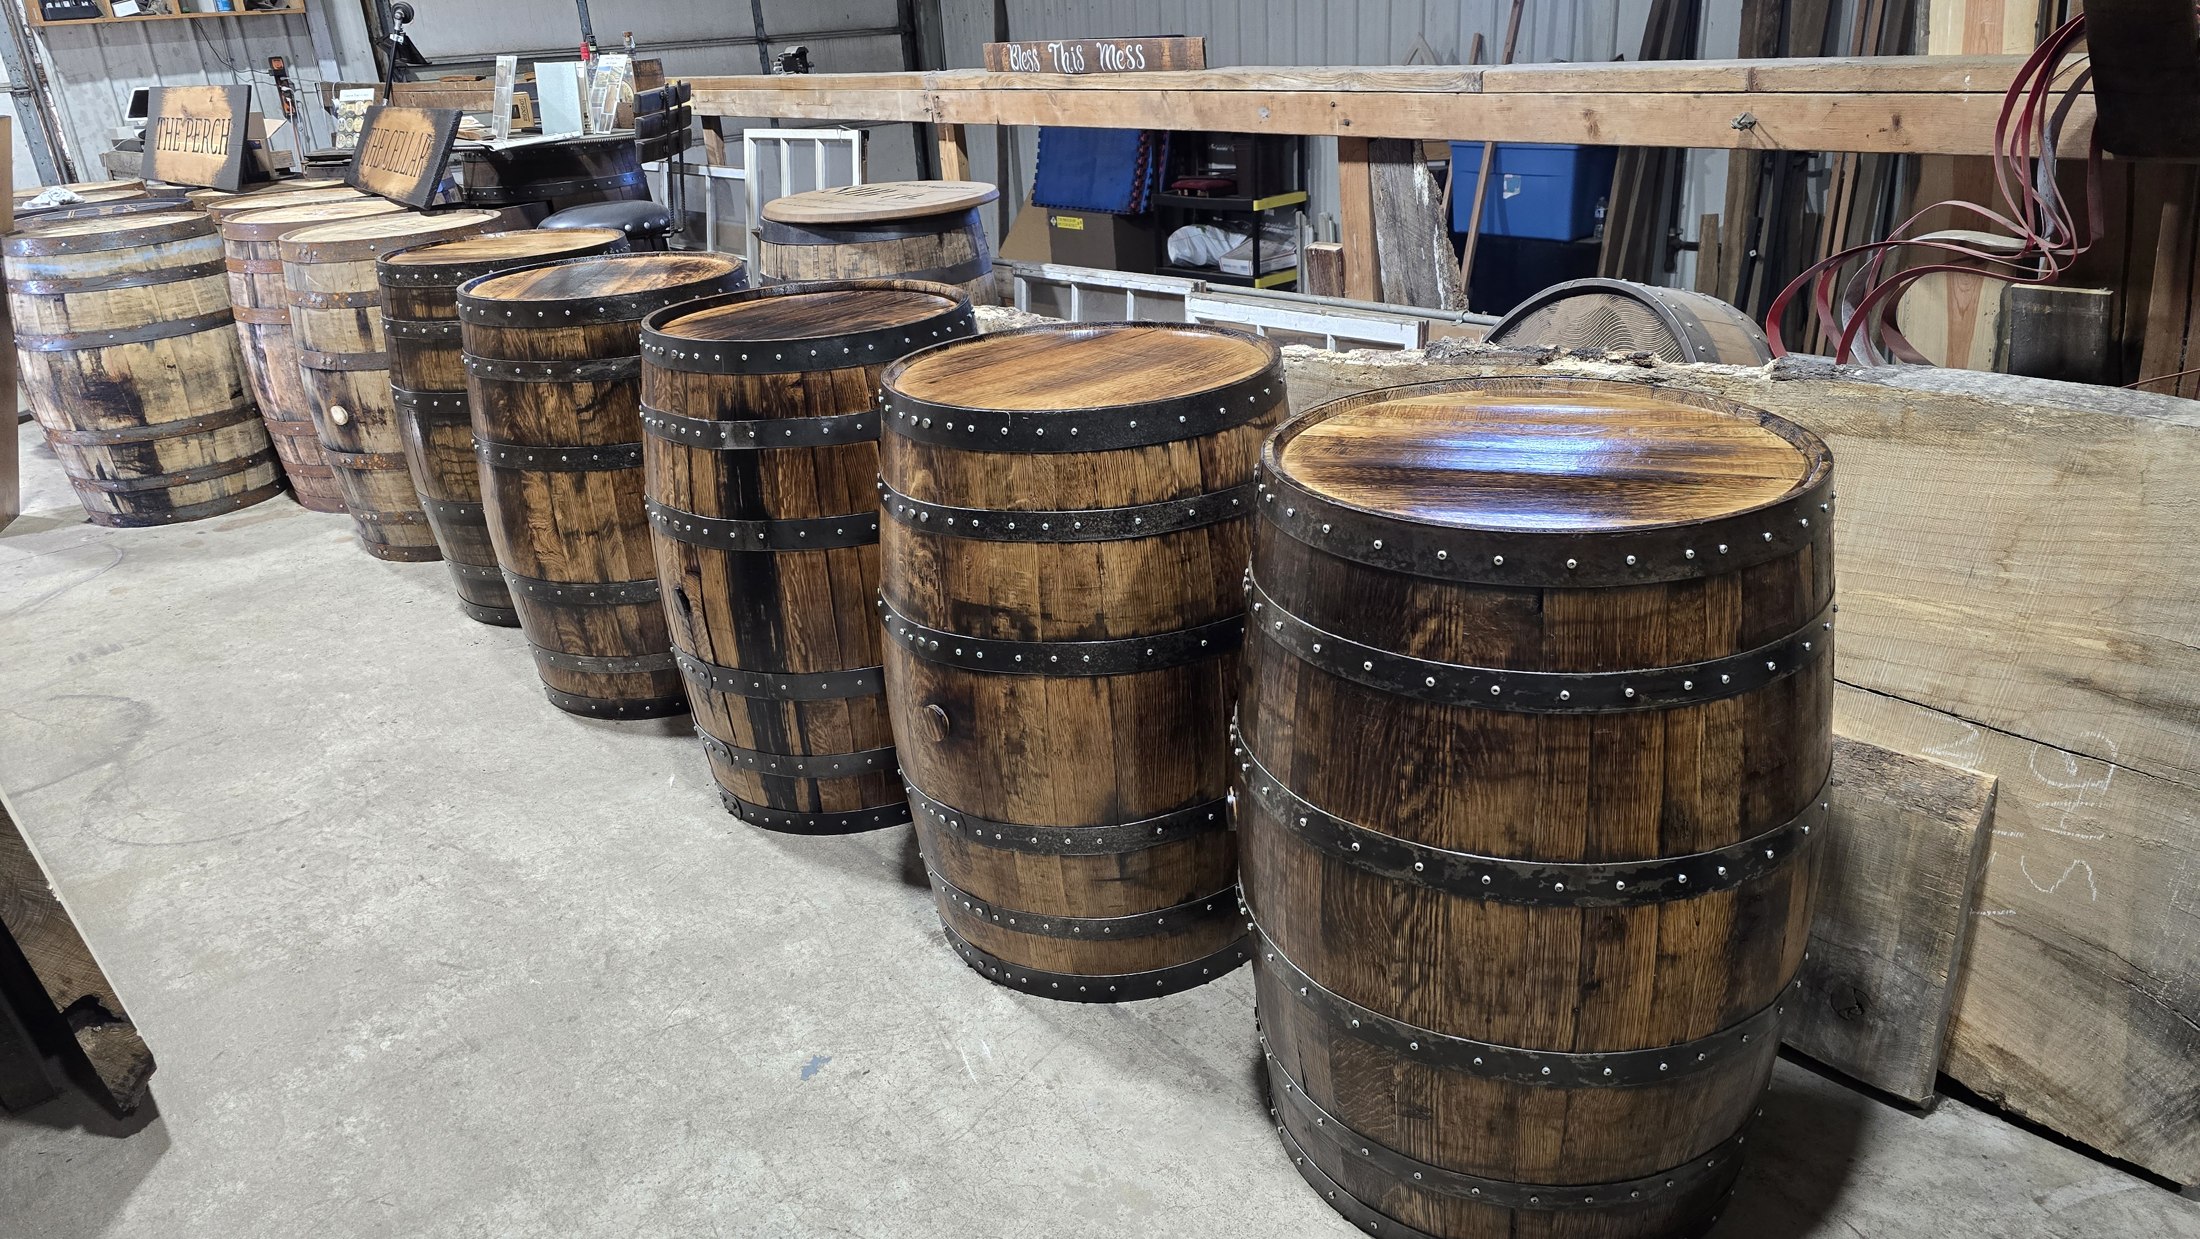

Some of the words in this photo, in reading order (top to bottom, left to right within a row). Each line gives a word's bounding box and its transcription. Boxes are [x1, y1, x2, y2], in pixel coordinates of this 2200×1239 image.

[1006, 43, 1041, 73] Bless
[1048, 41, 1085, 74] This
[1096, 42, 1145, 71] Mess
[156, 116, 183, 152] THE
[183, 117, 232, 156] PERCH
[360, 127, 390, 169] THE
[382, 129, 433, 178] CELLAR
